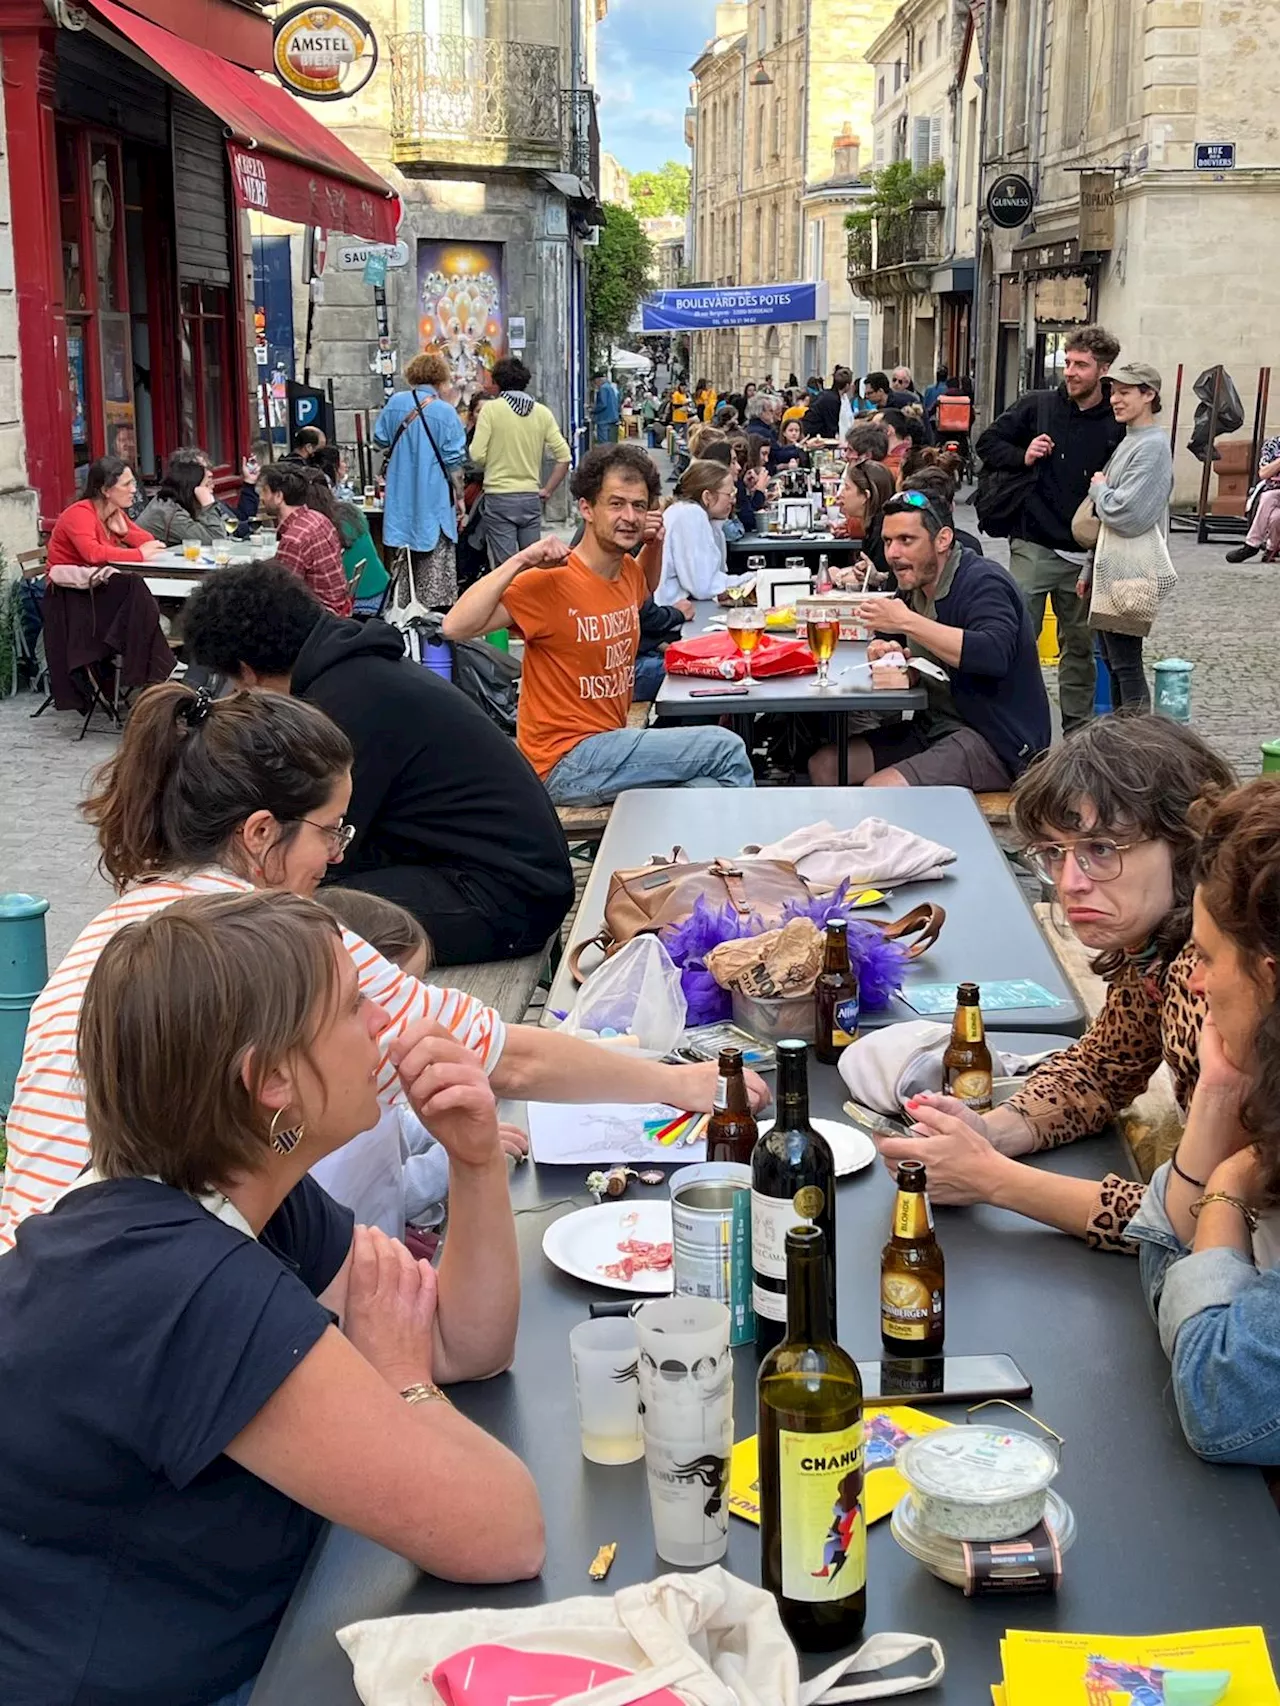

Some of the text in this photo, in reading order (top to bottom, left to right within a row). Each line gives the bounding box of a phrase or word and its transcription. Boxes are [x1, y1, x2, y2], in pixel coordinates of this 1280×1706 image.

[290, 37, 350, 52] AMSTEL
[1207, 146, 1223, 154] RUE
[992, 197, 1029, 207] GUINNESS
[675, 297, 737, 310] BOULEVARD
[738, 296, 758, 307] DES
[760, 293, 792, 306] POTES
[900, 1198, 910, 1231] BLONDE
